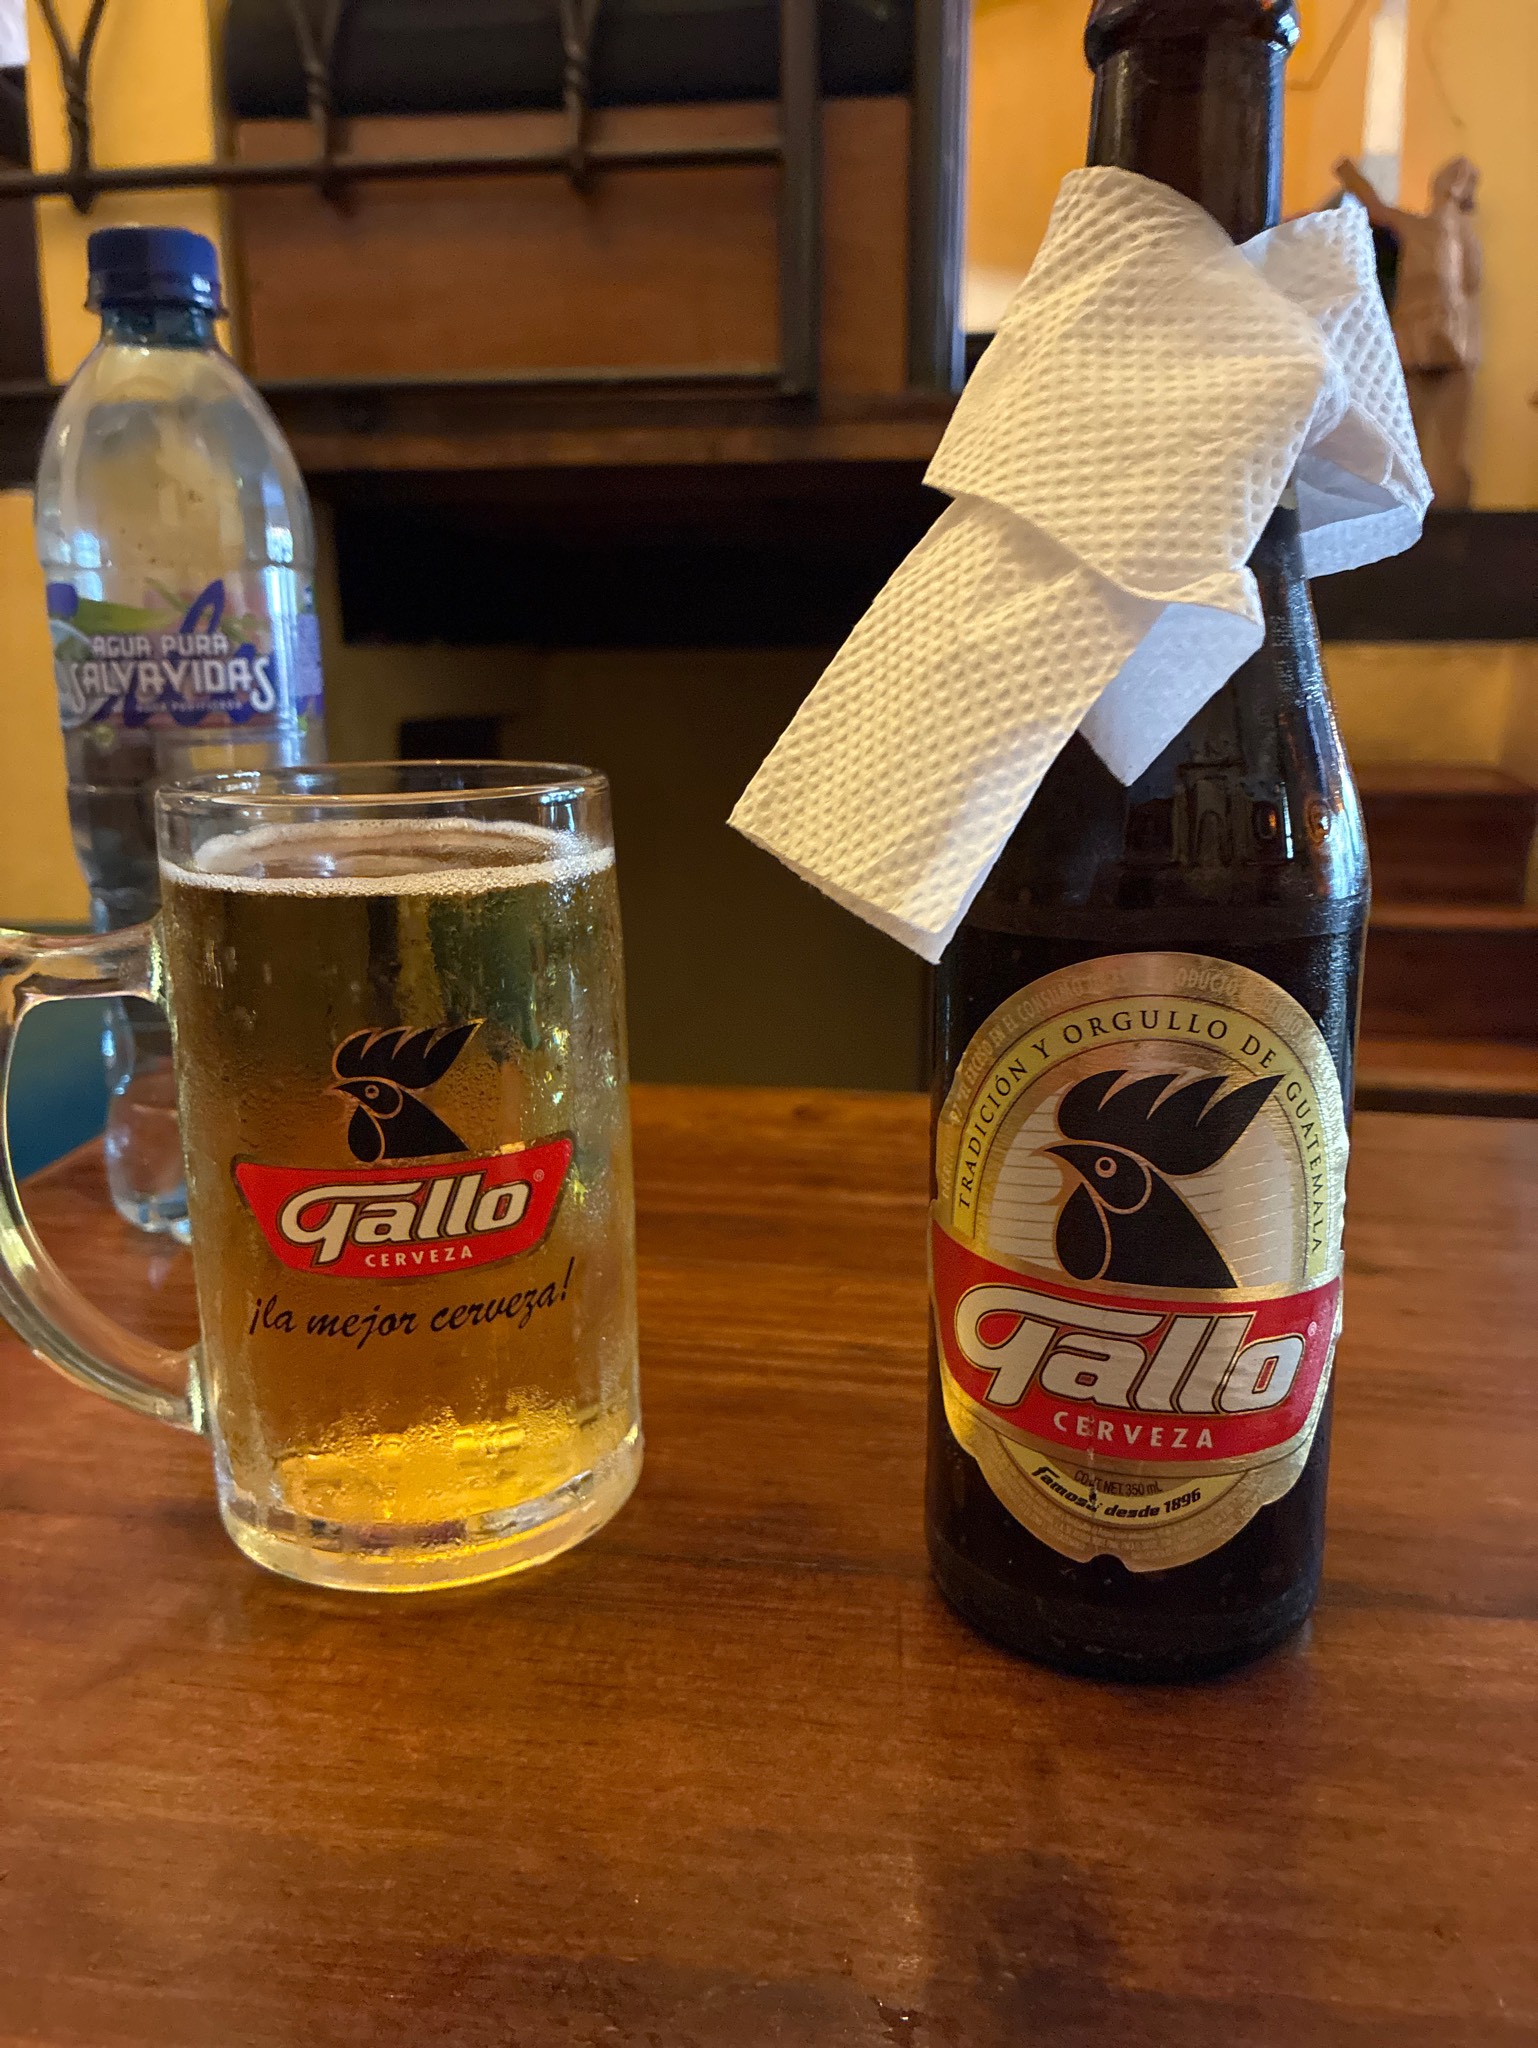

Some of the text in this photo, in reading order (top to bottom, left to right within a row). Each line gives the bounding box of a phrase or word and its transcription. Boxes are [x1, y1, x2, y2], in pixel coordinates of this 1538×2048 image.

[91, 633, 229, 657] AGUA PURA
[69, 656, 276, 713] SALVAVIDAS
[958, 1057, 1028, 1210] TRADICIÓN
[1031, 1037, 1051, 1060] Y
[1062, 1009, 1229, 1045] ORGULLO
[1239, 1033, 1277, 1070] DE
[1285, 1081, 1323, 1256] GUATEMALA
[364, 1244, 473, 1268] CERVEZA
[248, 1256, 576, 1349] ¡la mejor cerveza!
[1053, 1411, 1214, 1449] CERVEZA
[1104, 1504, 1160, 1519] desde
[1163, 1487, 1202, 1513] 1896
[1125, 1483, 1145, 1497] 350
